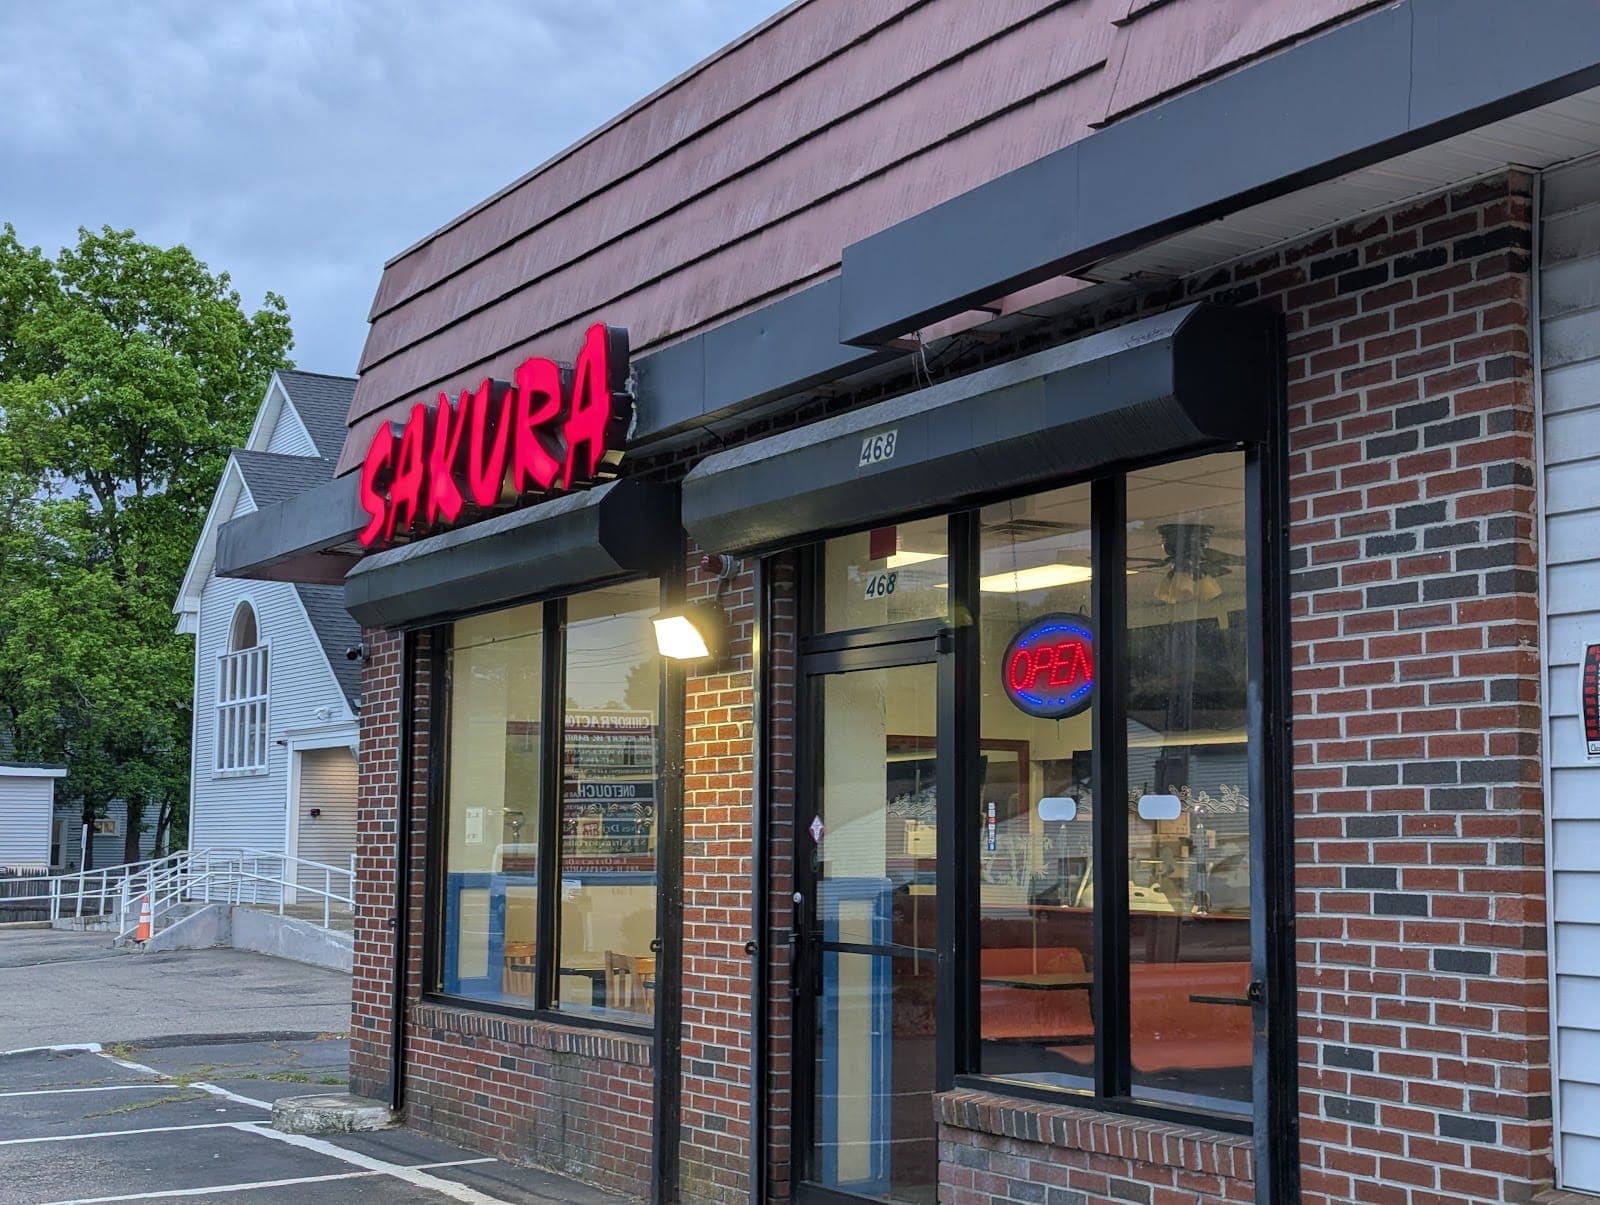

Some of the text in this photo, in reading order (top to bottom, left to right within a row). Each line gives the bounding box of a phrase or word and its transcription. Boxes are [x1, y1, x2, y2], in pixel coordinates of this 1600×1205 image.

[359, 322, 611, 547] SAKURA
[861, 432, 895, 463] 468
[866, 572, 897, 598] 468
[1008, 641, 1092, 690] OPEN
